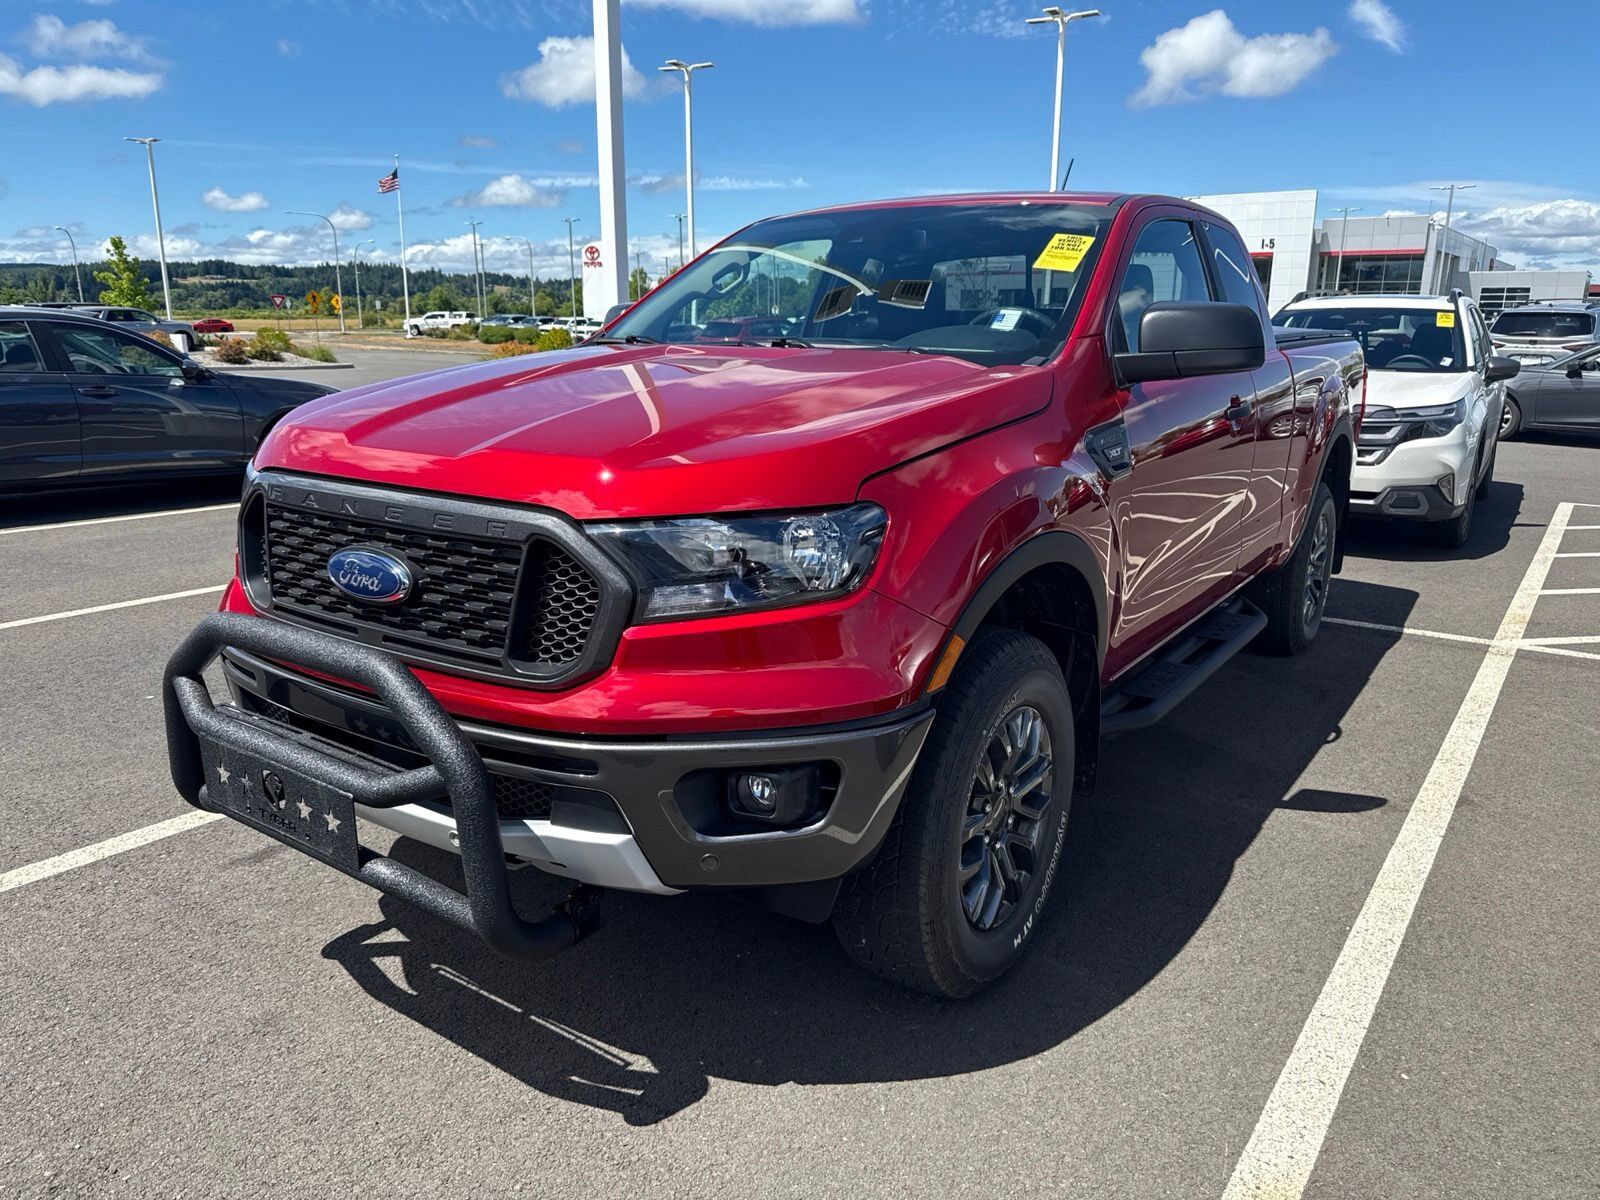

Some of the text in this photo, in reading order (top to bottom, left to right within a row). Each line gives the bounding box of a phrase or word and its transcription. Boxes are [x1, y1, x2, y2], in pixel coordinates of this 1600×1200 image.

[1261, 238, 1275, 249] I-5
[1110, 447, 1122, 458] XLT
[268, 486, 510, 539] RANGER
[339, 558, 384, 592] Ford
